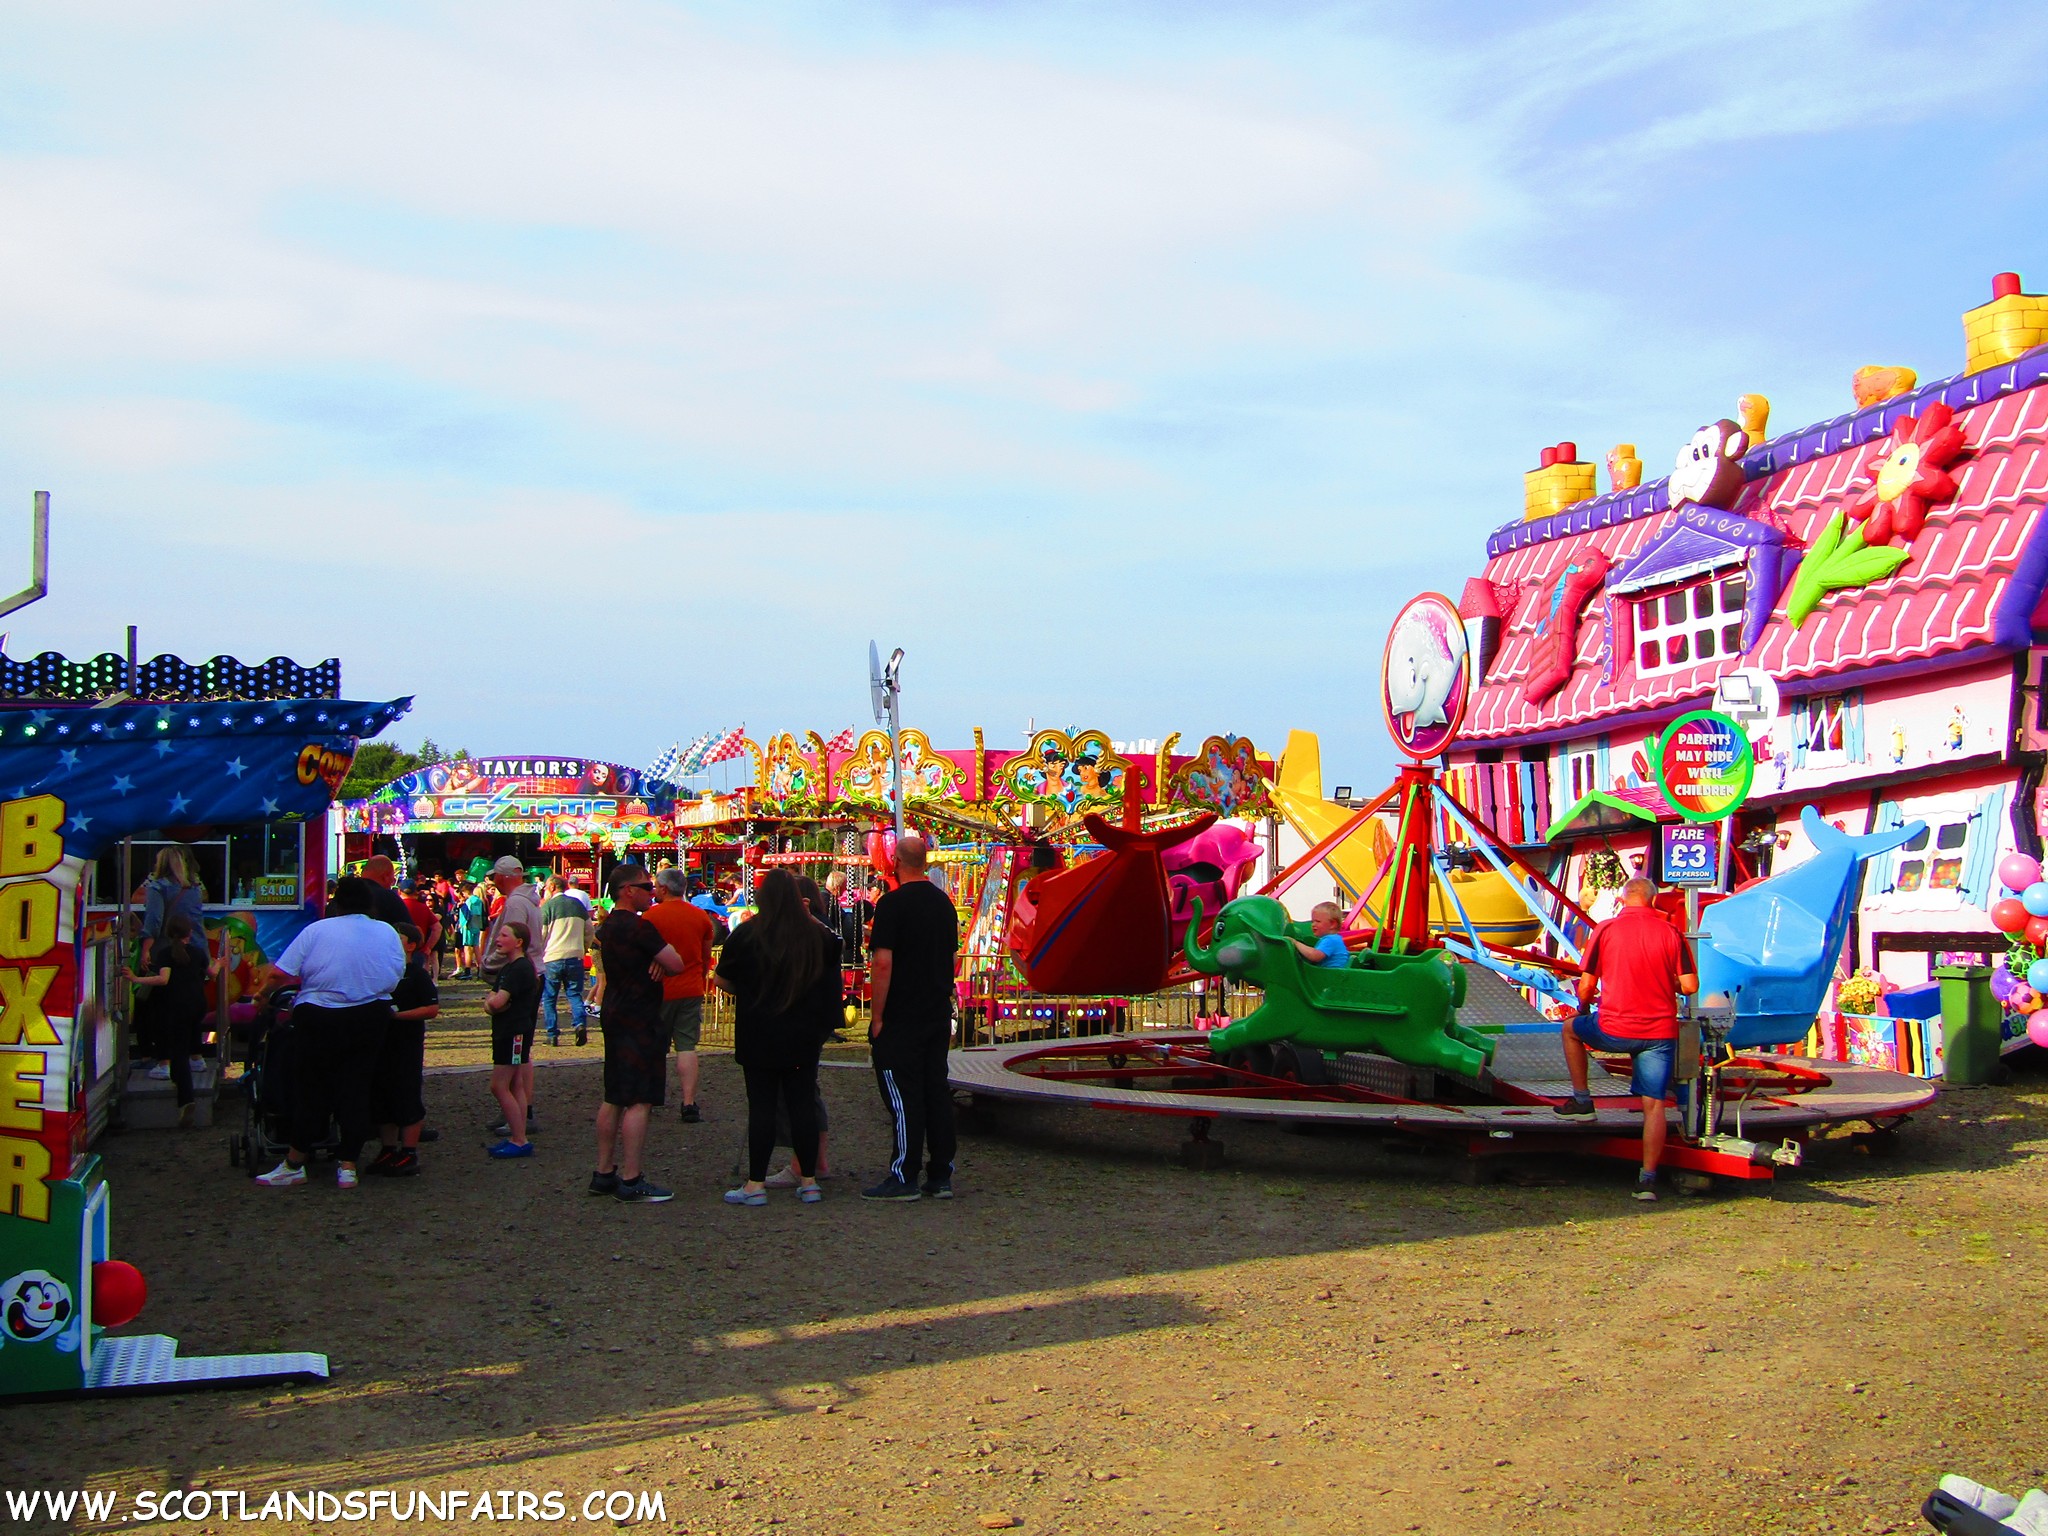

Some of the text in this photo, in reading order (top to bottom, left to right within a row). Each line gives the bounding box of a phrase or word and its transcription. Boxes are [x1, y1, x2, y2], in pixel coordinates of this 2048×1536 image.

[1677, 733, 1731, 746] PARENTS
[1675, 750, 1733, 763] MAY RIDE
[481, 760, 578, 776] TAYLOR'S
[1687, 767, 1722, 779] WITH
[1674, 784, 1735, 797] CHILDREN
[443, 783, 618, 822] ECSTATIC
[1671, 829, 1705, 841] FARE
[1670, 843, 1707, 868] £3
[259, 884, 295, 896] £4.00
[0, 793, 67, 1224] BOXER
